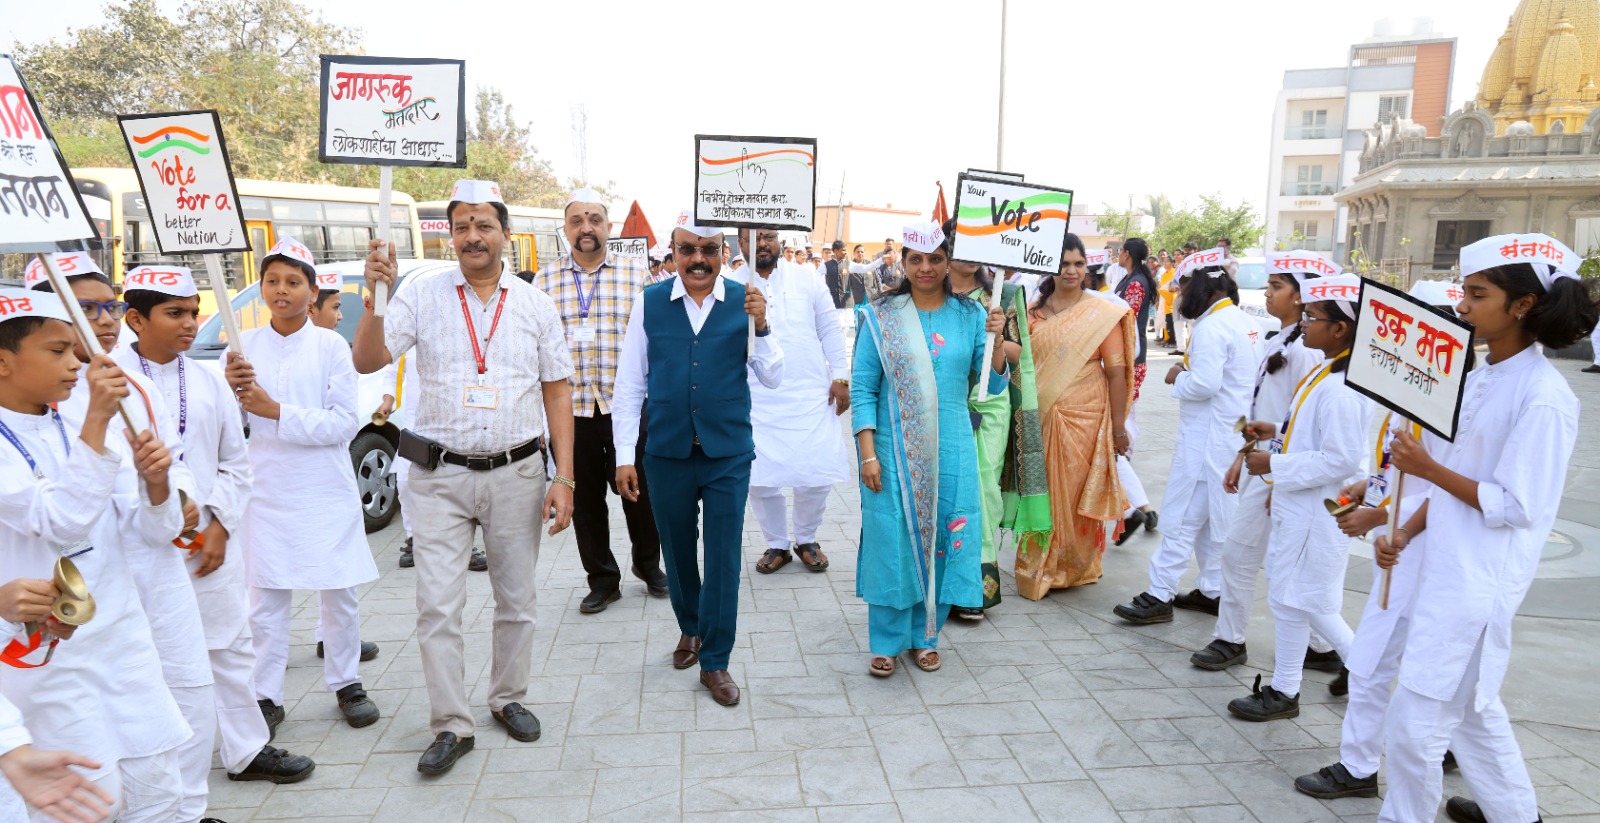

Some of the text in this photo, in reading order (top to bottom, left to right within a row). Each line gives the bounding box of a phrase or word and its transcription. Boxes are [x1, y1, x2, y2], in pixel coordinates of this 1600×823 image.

[382, 97, 440, 129] मतदार
[152, 155, 196, 186] Vote
[177, 188, 231, 211] for a
[967, 184, 988, 197] Your
[165, 213, 201, 230] better
[419, 221, 451, 230] CHOO
[990, 196, 1042, 233] Vote
[178, 230, 231, 246] Nation
[1000, 233, 1022, 247] Your
[1023, 243, 1053, 267] Voice
[1368, 298, 1464, 376] एक मत
